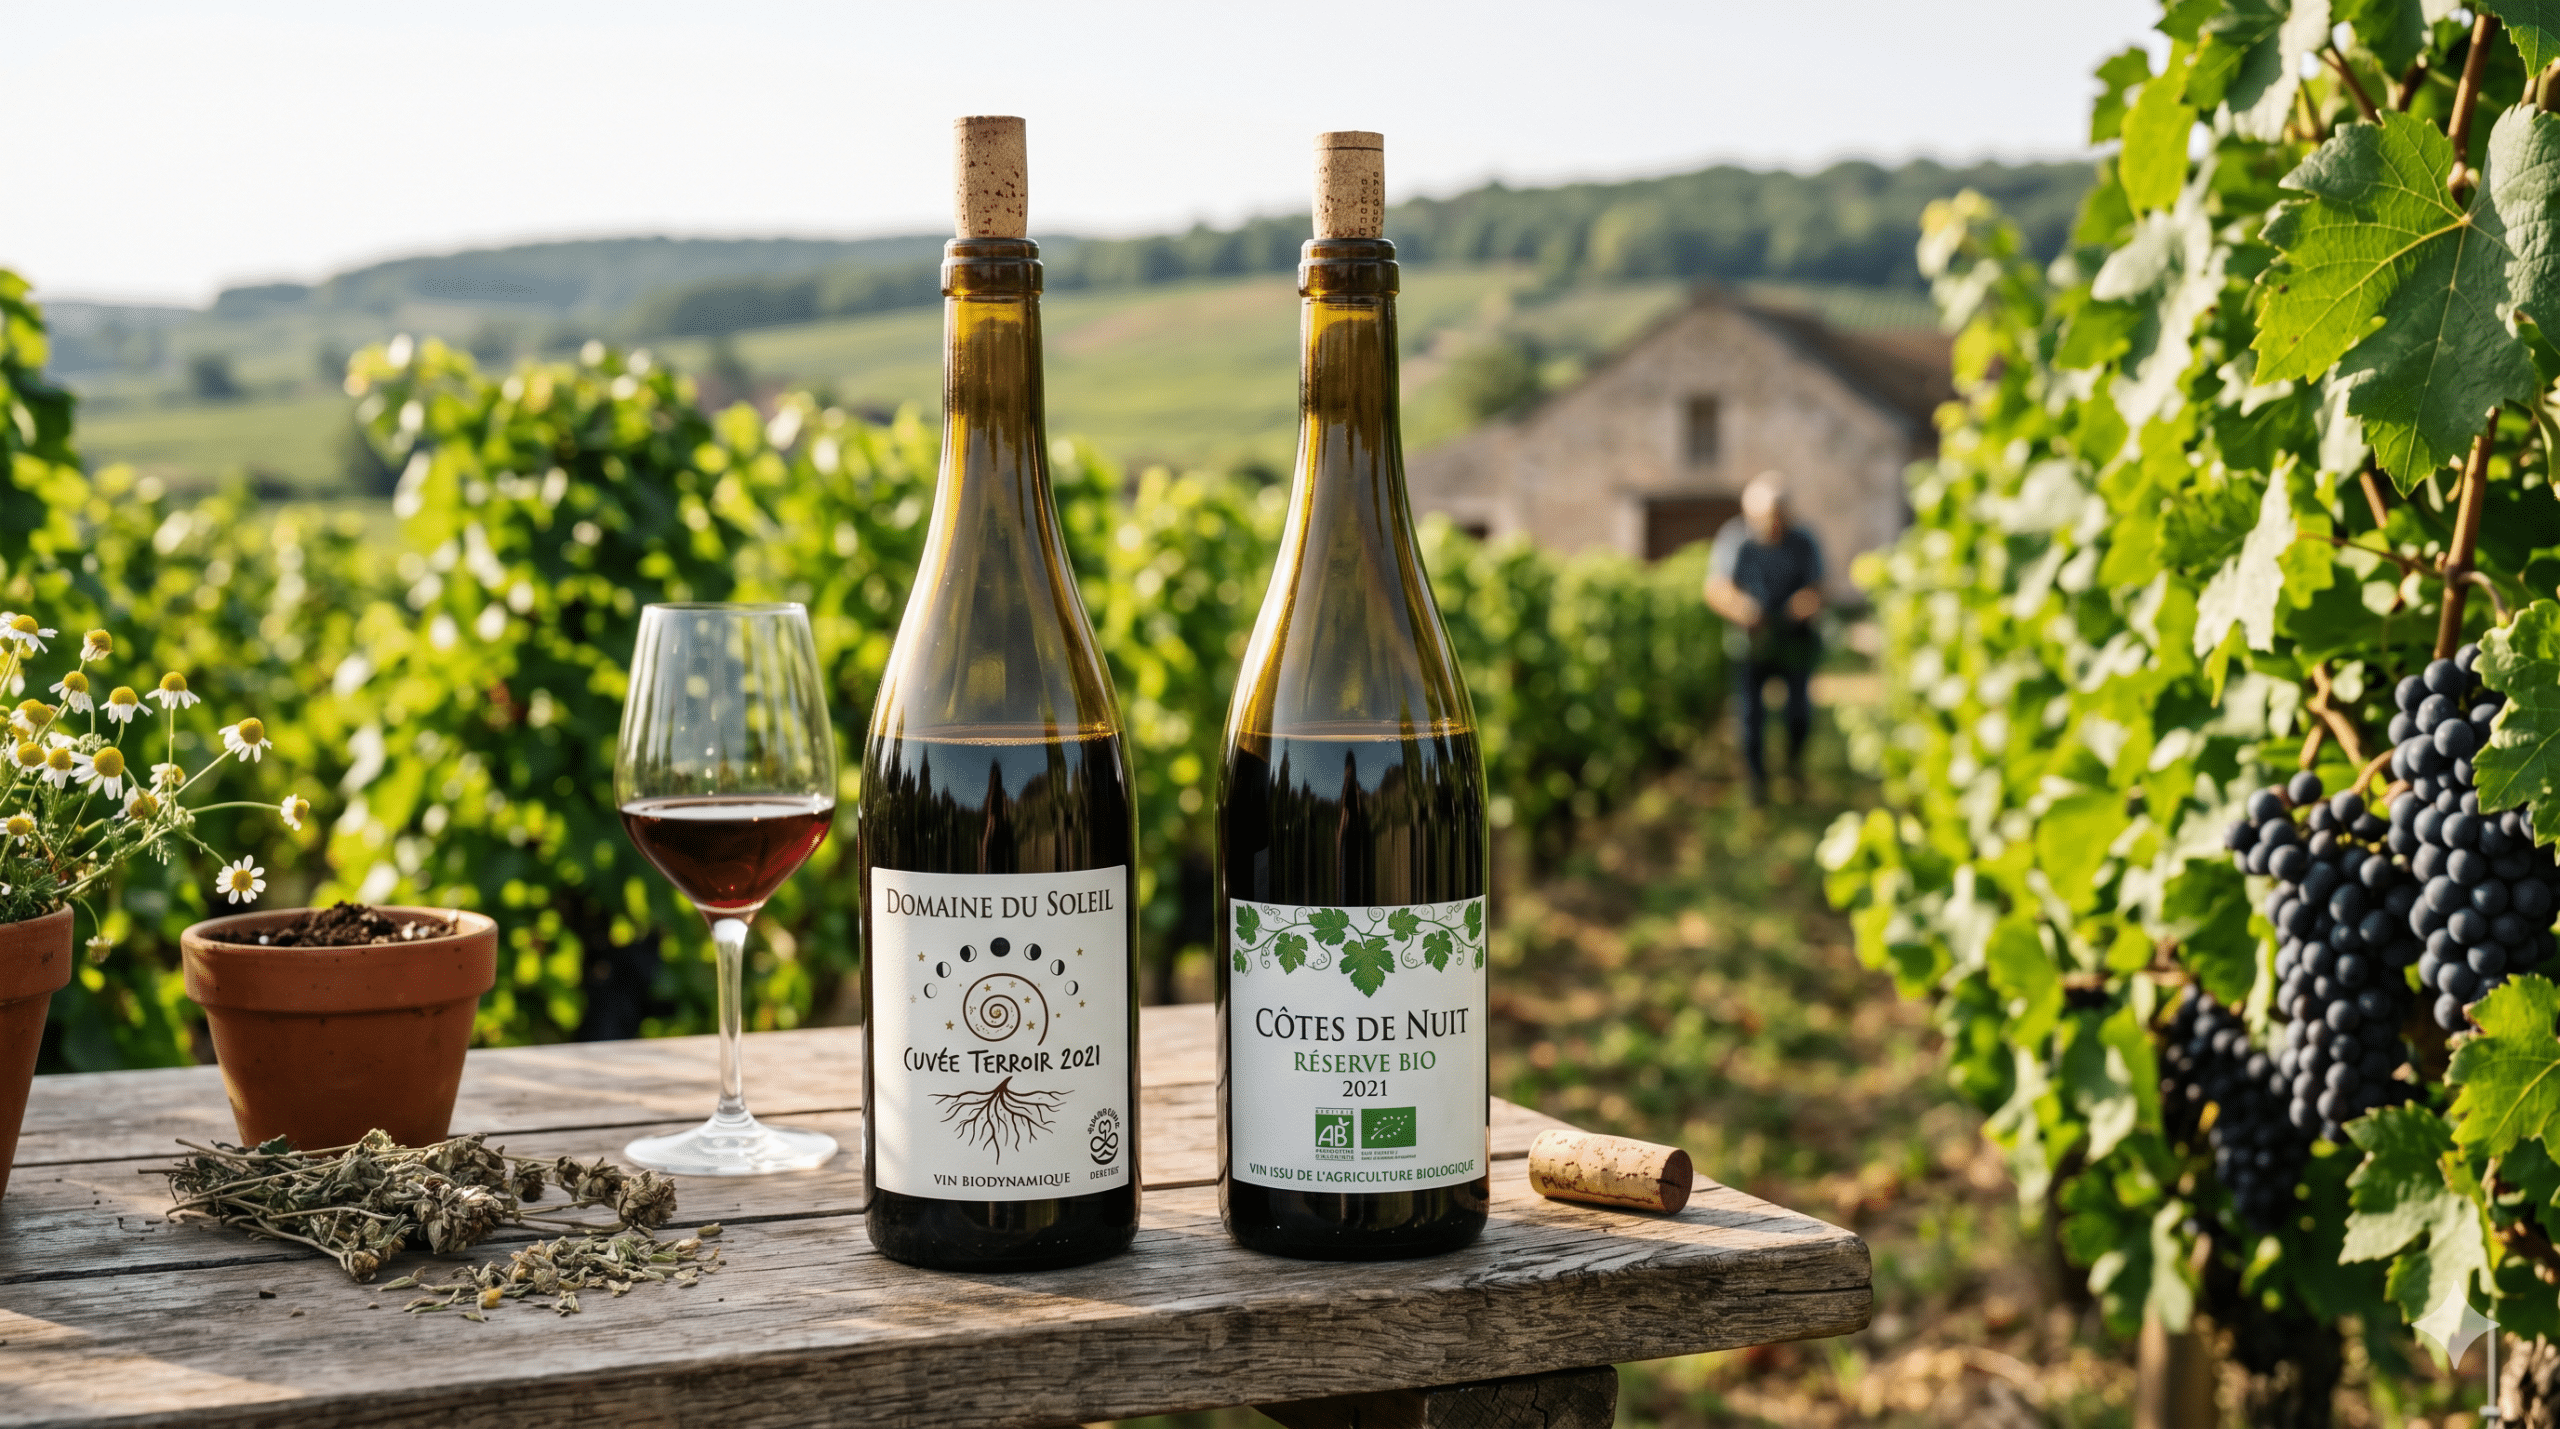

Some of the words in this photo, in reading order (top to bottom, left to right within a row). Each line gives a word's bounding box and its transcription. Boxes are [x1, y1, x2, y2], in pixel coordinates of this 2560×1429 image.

[886, 888, 993, 918] DOMAINE
[1001, 896, 1038, 919] DU
[1047, 889, 1114, 916] SOLEIL
[1255, 1006, 1345, 1042] CÔTES
[1356, 1016, 1396, 1042] DE
[1406, 1007, 1469, 1040] NUIT
[904, 1047, 960, 1073] CUVÉE
[967, 1049, 1053, 1074] TERROIR
[1060, 1045, 1100, 1070] 2021
[1294, 1049, 1391, 1074] RÉSERVE
[1399, 1051, 1437, 1072] BIO
[1342, 1080, 1388, 1098] 2021
[1317, 1124, 1348, 1147] AB
[933, 1173, 958, 1187] VIN
[962, 1172, 1071, 1187] BIODYNAMIQUE
[1249, 1163, 1267, 1177] VIN
[1270, 1167, 1293, 1180] ISSU
[1297, 1170, 1313, 1182] DE
[1316, 1169, 1413, 1183] L'AGRICULTURE
[1416, 1159, 1475, 1180] BIOLOGIQUE
